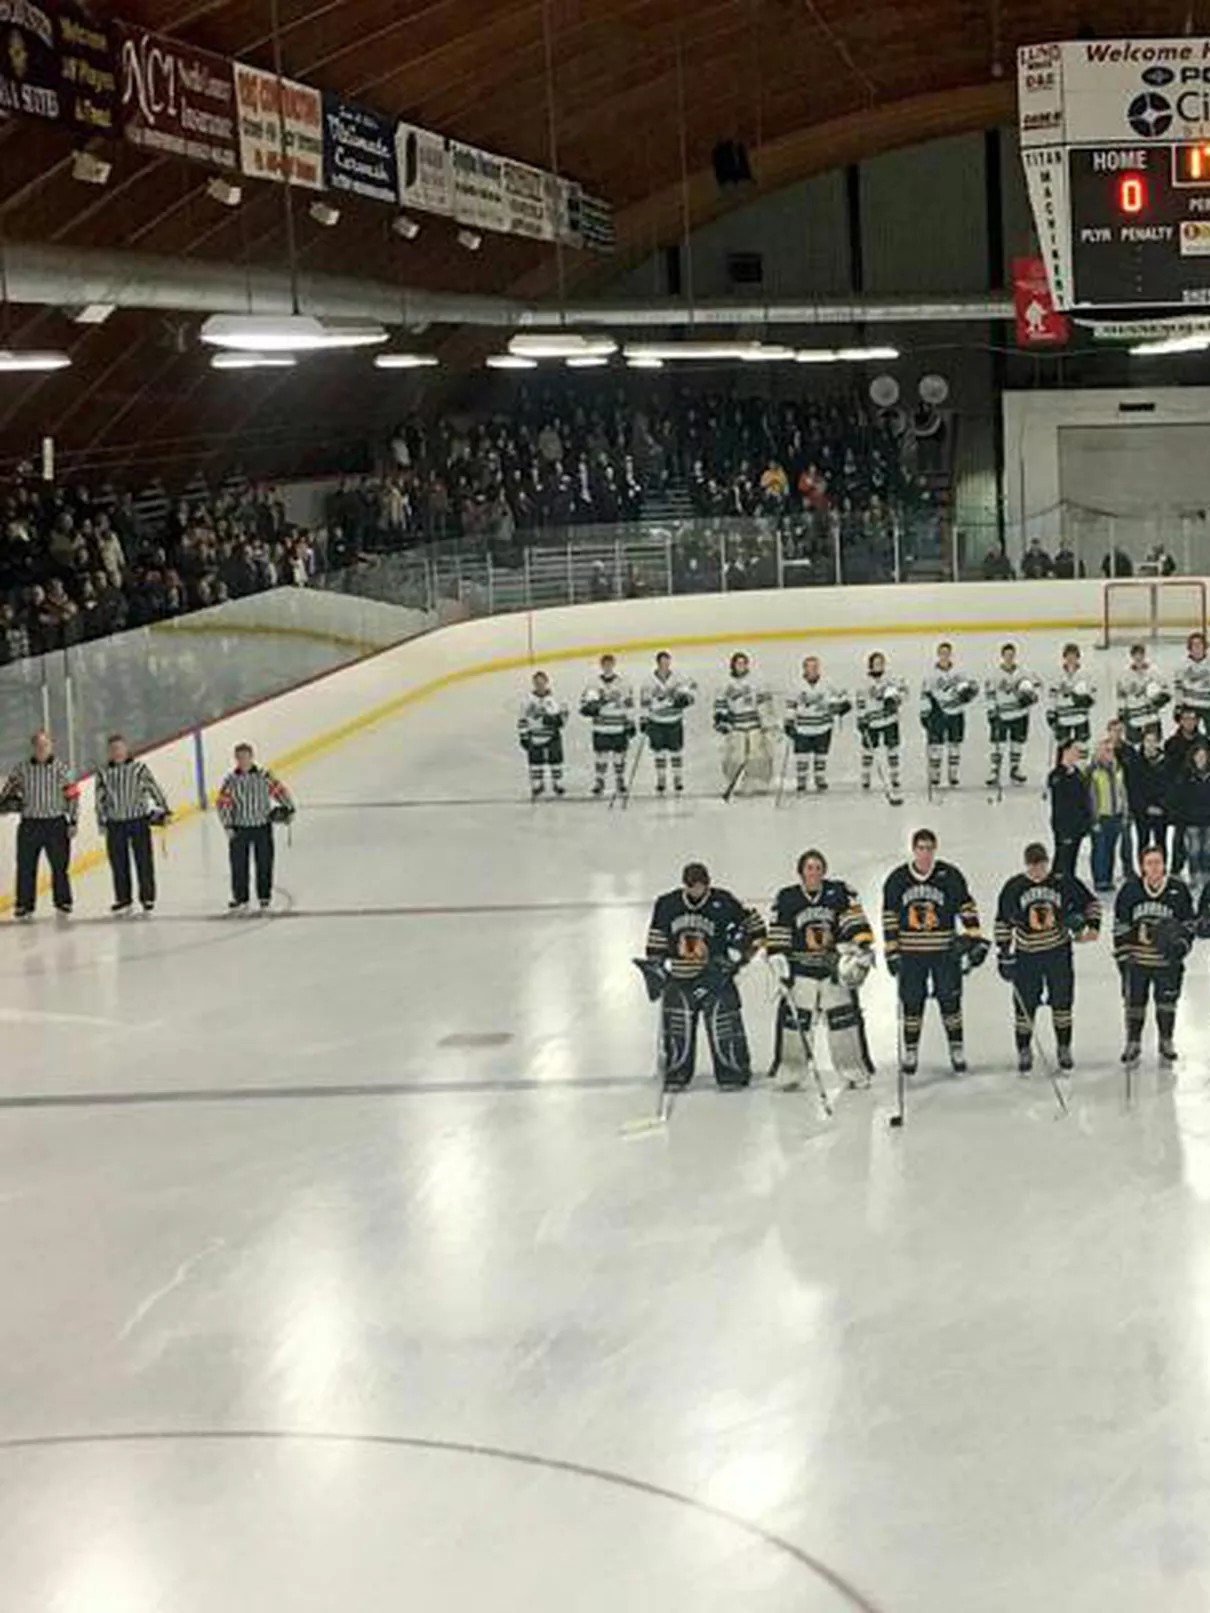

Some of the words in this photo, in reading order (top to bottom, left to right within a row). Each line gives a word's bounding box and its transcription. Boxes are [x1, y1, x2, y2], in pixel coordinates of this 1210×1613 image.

[1086, 42, 1193, 63] Welcome
[1093, 151, 1148, 171] HOME
[1122, 179, 1143, 212] 0
[1120, 226, 1173, 242] PENALTY
